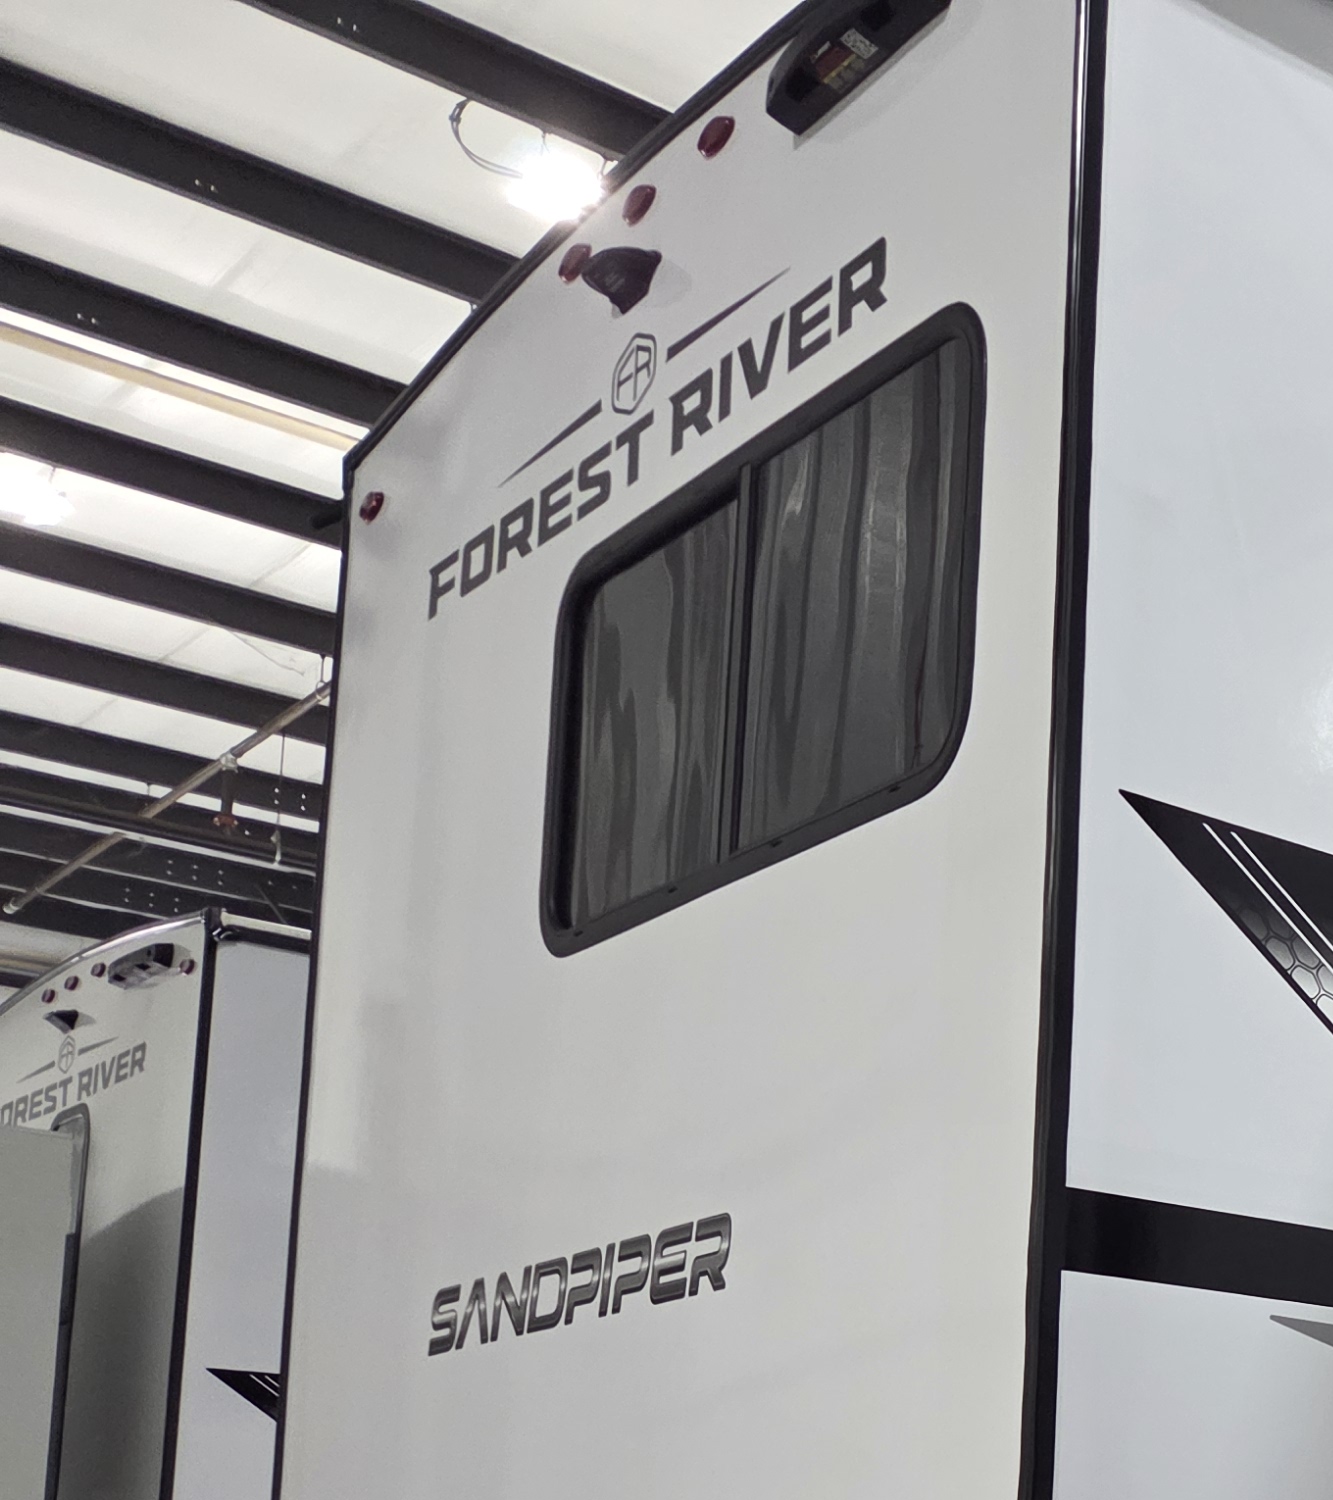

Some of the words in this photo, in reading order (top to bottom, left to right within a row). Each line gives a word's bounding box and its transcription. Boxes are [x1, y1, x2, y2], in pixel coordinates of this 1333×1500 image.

[427, 409, 655, 621] FOREST
[668, 236, 889, 456] RIVER
[77, 1041, 147, 1101] RIVER
[427, 1212, 732, 1357] SANDPIPER
